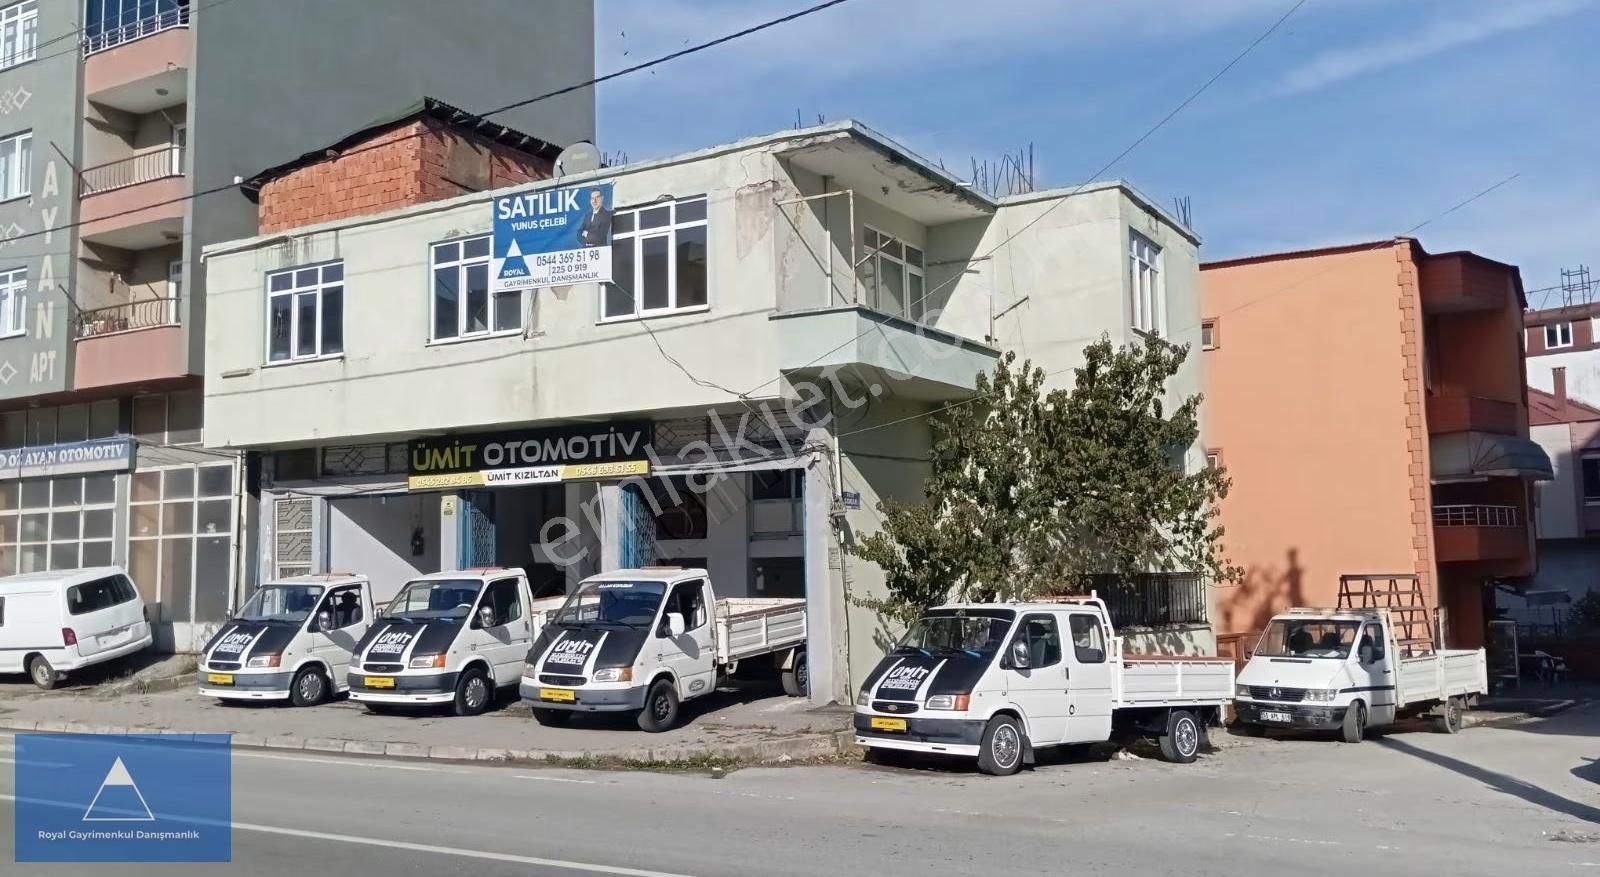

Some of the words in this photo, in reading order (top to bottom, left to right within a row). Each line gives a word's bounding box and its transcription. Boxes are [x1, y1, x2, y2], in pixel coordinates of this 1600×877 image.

[498, 188, 580, 220] SATILIK
[511, 219, 538, 231] YUNUS
[539, 215, 567, 230] ÇELEBİ
[536, 255, 557, 266] 0544
[559, 252, 574, 264] 369
[576, 250, 586, 262] 51
[589, 249, 600, 260] 98
[503, 268, 525, 277] ROYAL
[30, 350, 56, 384] APT
[60, 442, 124, 462] OTOMOTİV
[413, 440, 477, 470] ÜMİT
[483, 426, 641, 466] OTOMOTİV
[487, 471, 512, 482] ÜMİT
[514, 469, 559, 480] KIZILTAN
